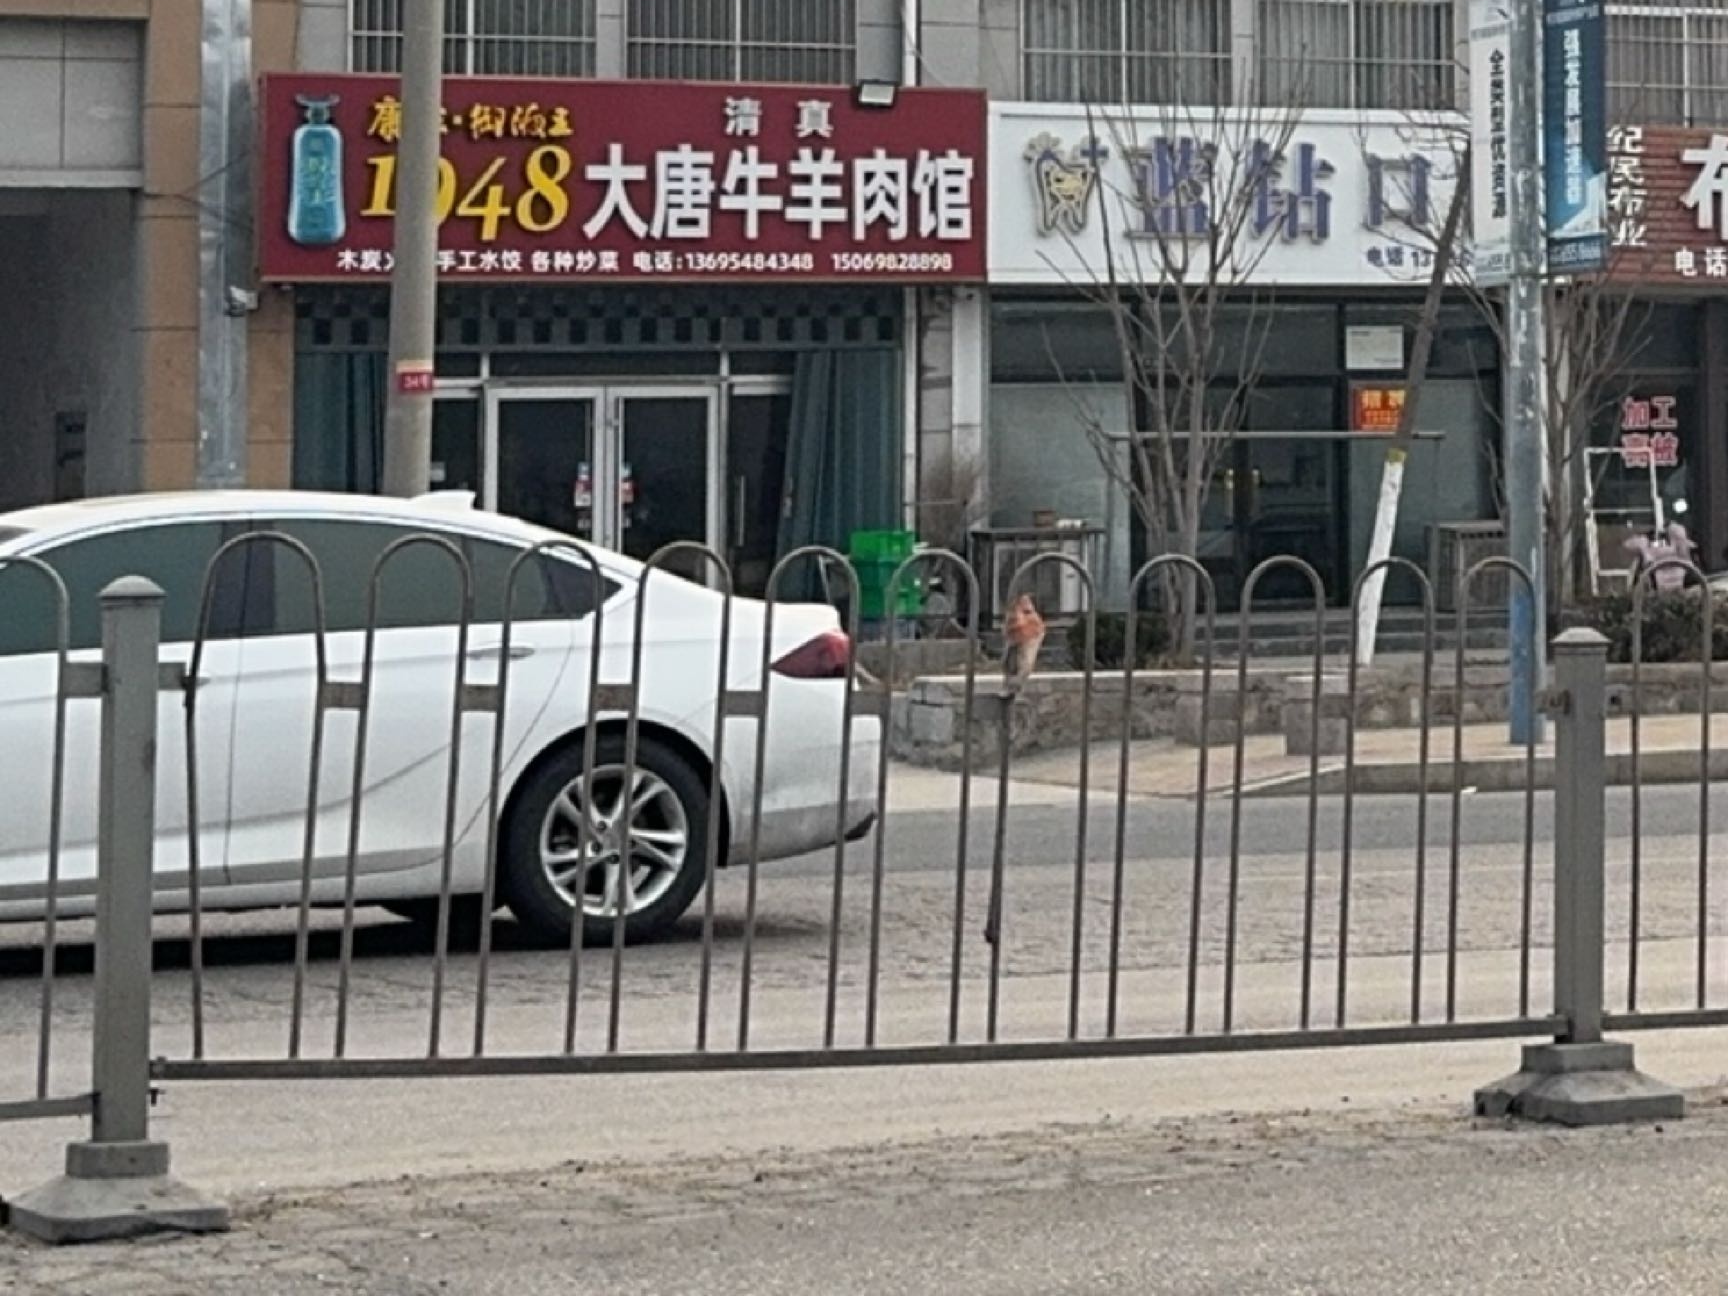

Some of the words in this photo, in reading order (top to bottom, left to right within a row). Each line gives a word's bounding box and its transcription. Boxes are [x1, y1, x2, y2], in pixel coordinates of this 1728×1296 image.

[724, 97, 834, 137] 清真
[583, 144, 975, 242] 大唐牛羊肉馆
[437, 249, 522, 272] 手工水饺
[531, 249, 620, 273] 各种炒菜
